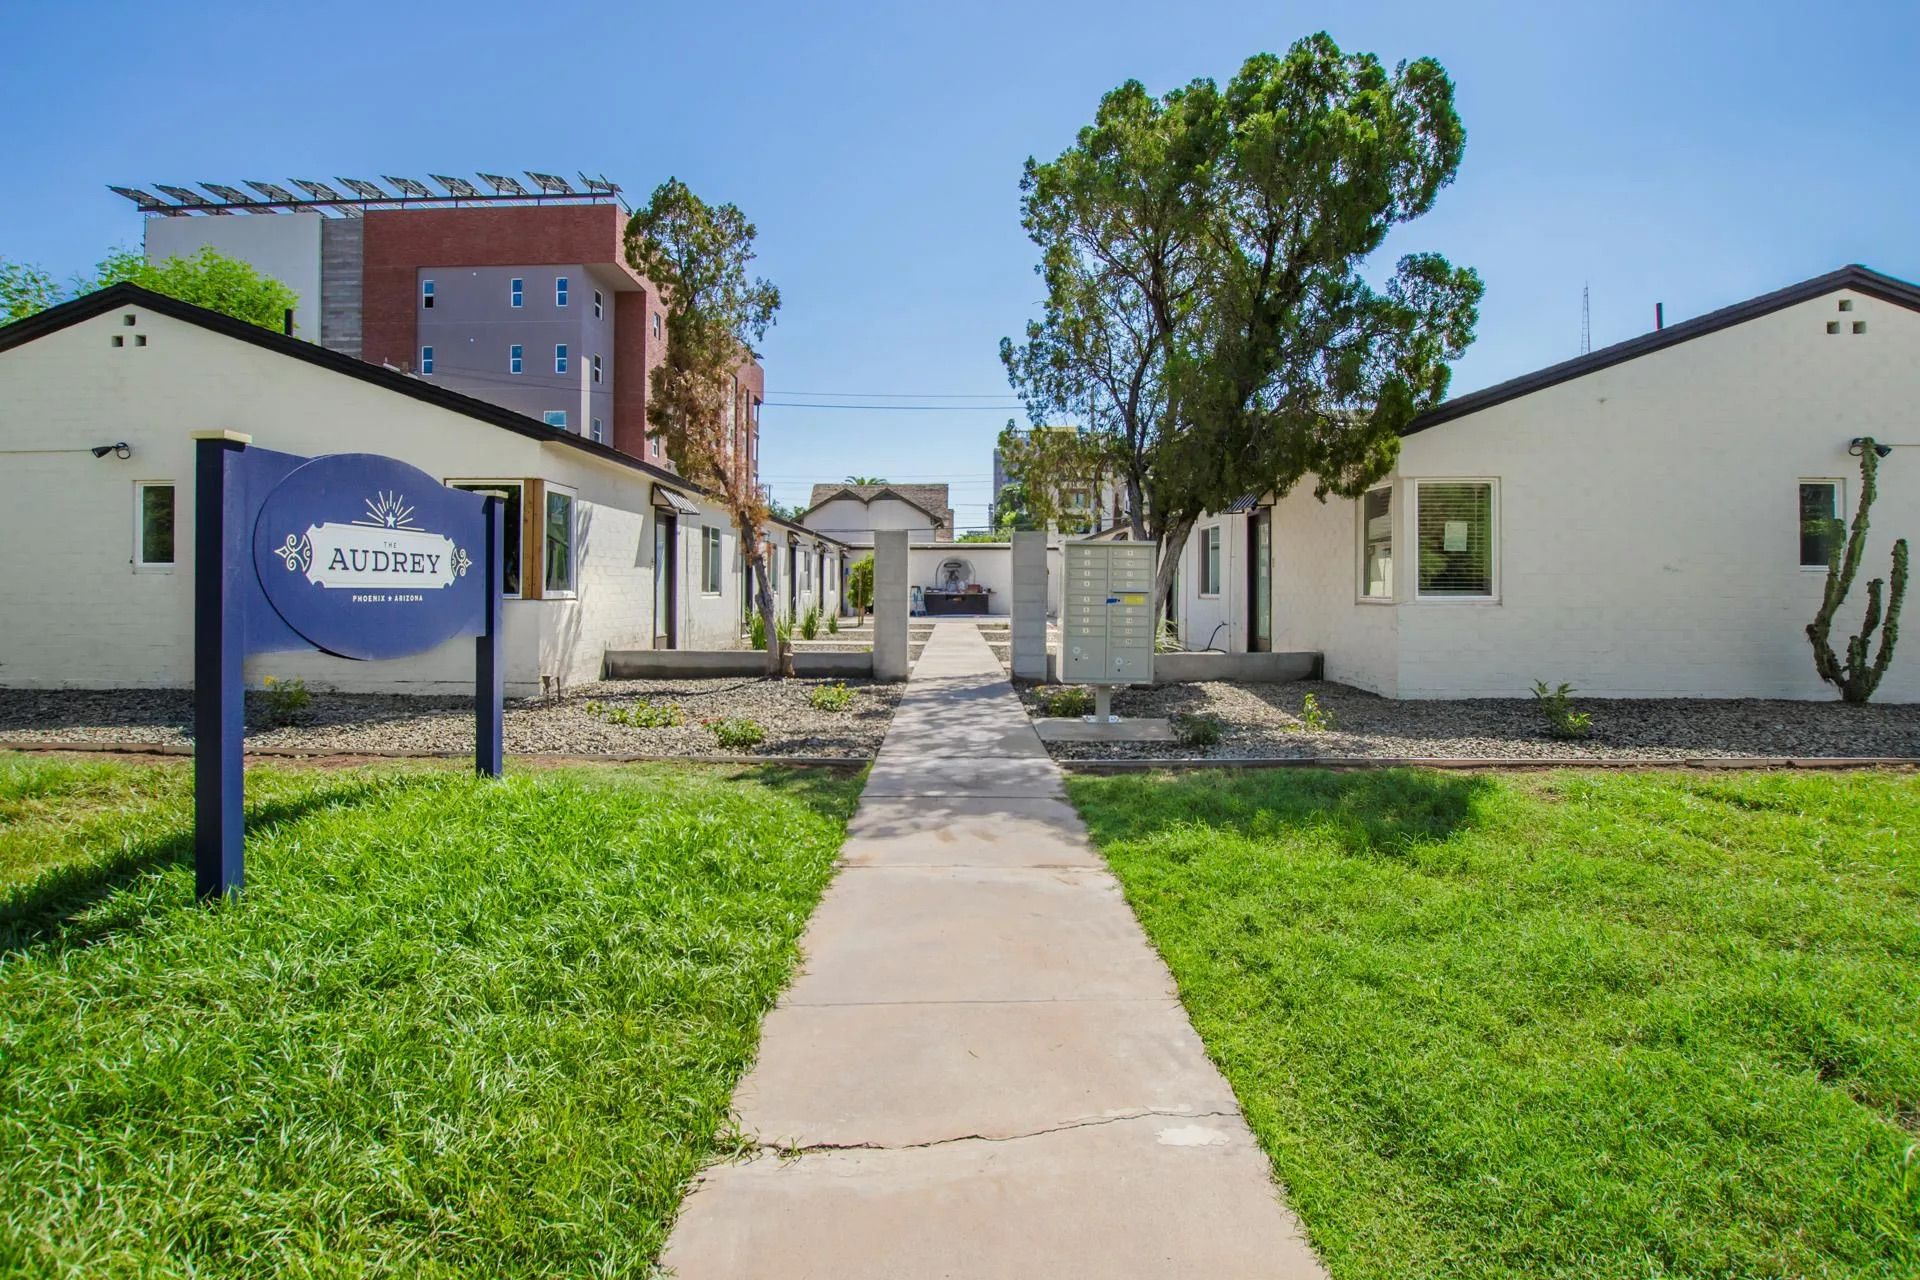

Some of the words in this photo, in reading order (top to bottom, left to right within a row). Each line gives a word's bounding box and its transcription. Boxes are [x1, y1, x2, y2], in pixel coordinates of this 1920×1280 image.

[384, 541, 397, 549] THE
[328, 547, 441, 574] AUDREY
[352, 595, 385, 603] PHOENIX
[394, 594, 424, 602] ARIZONA
